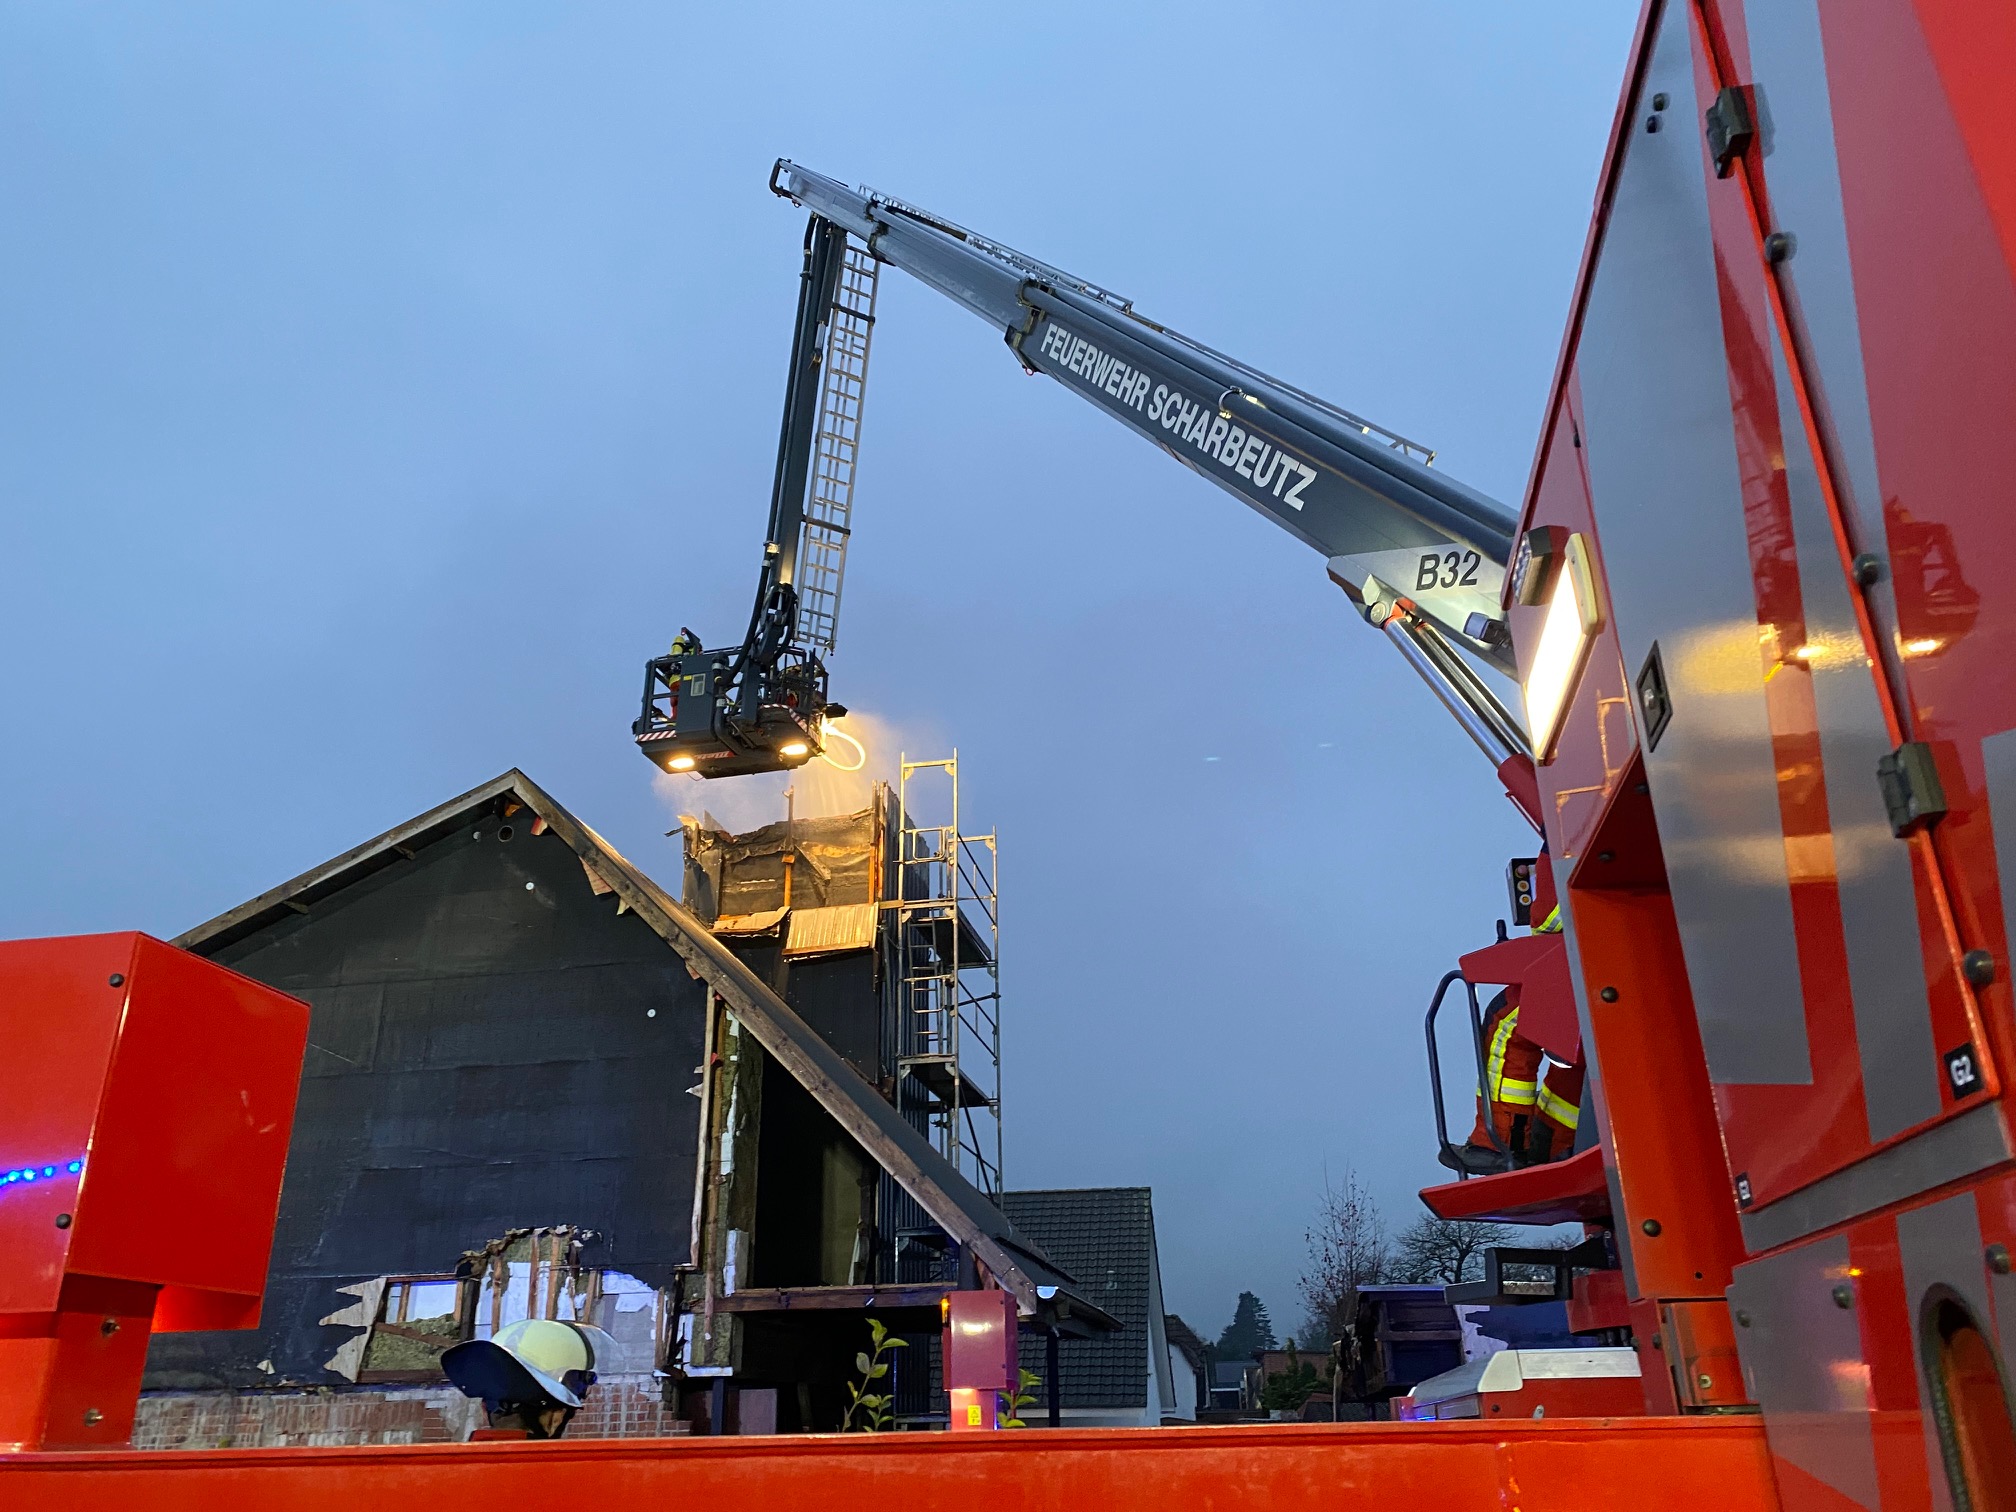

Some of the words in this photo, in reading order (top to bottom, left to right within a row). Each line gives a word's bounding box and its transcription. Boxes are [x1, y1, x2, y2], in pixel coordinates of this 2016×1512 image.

[1040, 323, 1152, 412] FEUERWEHR
[1147, 384, 1318, 512] SCHARBEUTZ
[1416, 549, 1482, 591] B32
